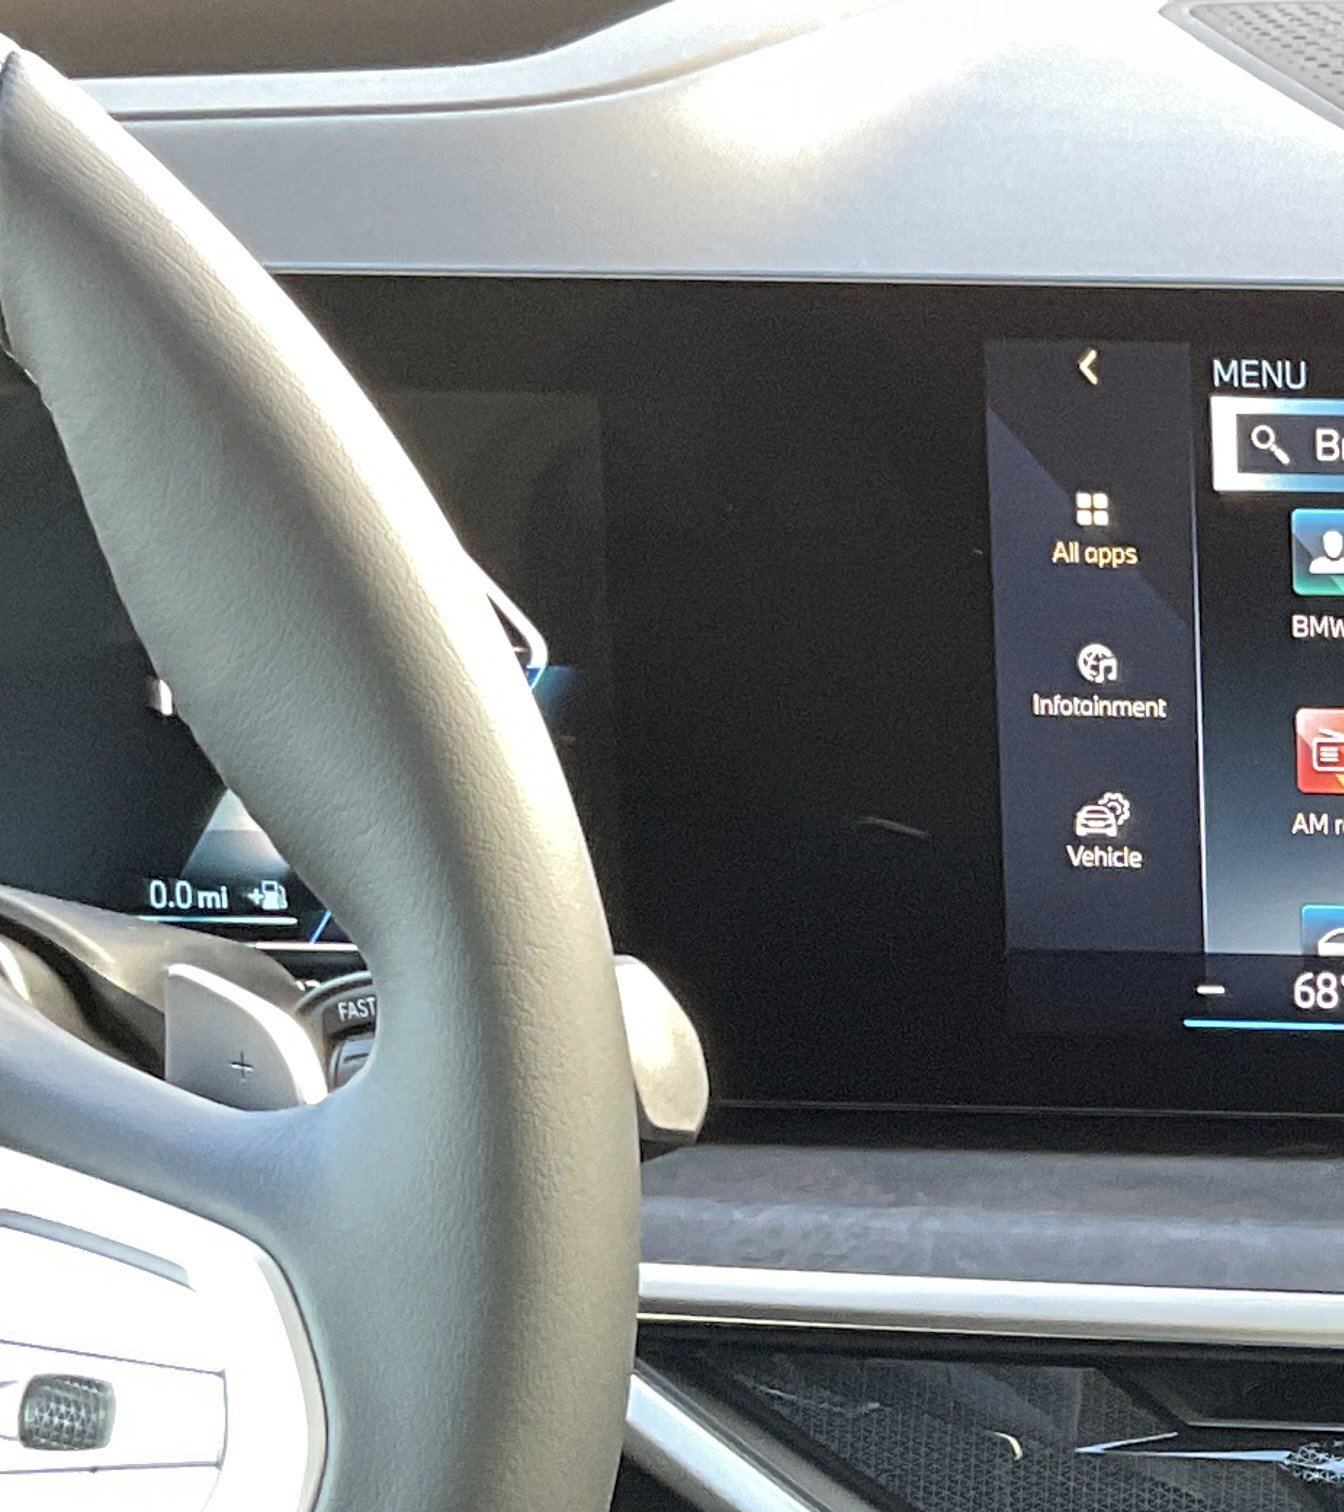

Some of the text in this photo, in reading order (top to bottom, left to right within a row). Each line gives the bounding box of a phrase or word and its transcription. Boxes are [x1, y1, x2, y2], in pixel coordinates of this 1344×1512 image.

[1213, 359, 1306, 390] MENU
[1051, 541, 1138, 569] All apps
[1033, 693, 1167, 718] Infotainment
[1291, 812, 1329, 835] AM
[1066, 844, 1143, 869] Vehicle
[149, 879, 229, 910] 0.0 mi
[338, 997, 376, 1020] FAST
